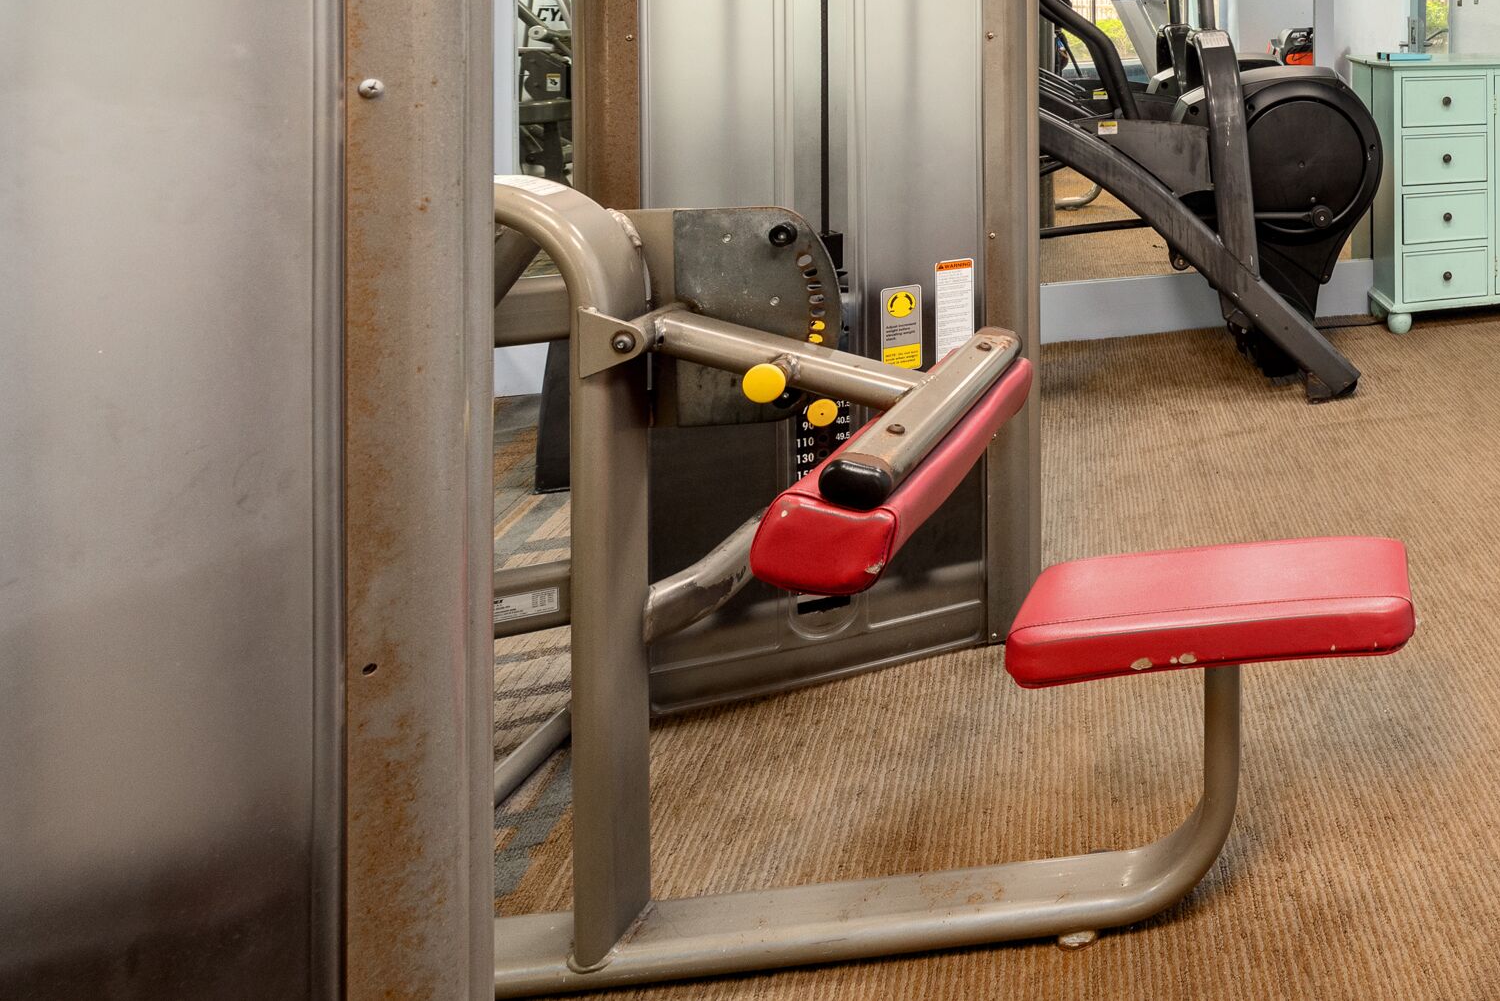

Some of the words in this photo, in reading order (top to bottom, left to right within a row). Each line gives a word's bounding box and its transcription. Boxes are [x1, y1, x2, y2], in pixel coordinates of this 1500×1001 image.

[836, 416, 850, 424] 40.5
[797, 437, 814, 448] 110
[836, 432, 850, 440] 49.5
[797, 453, 814, 464] 130
